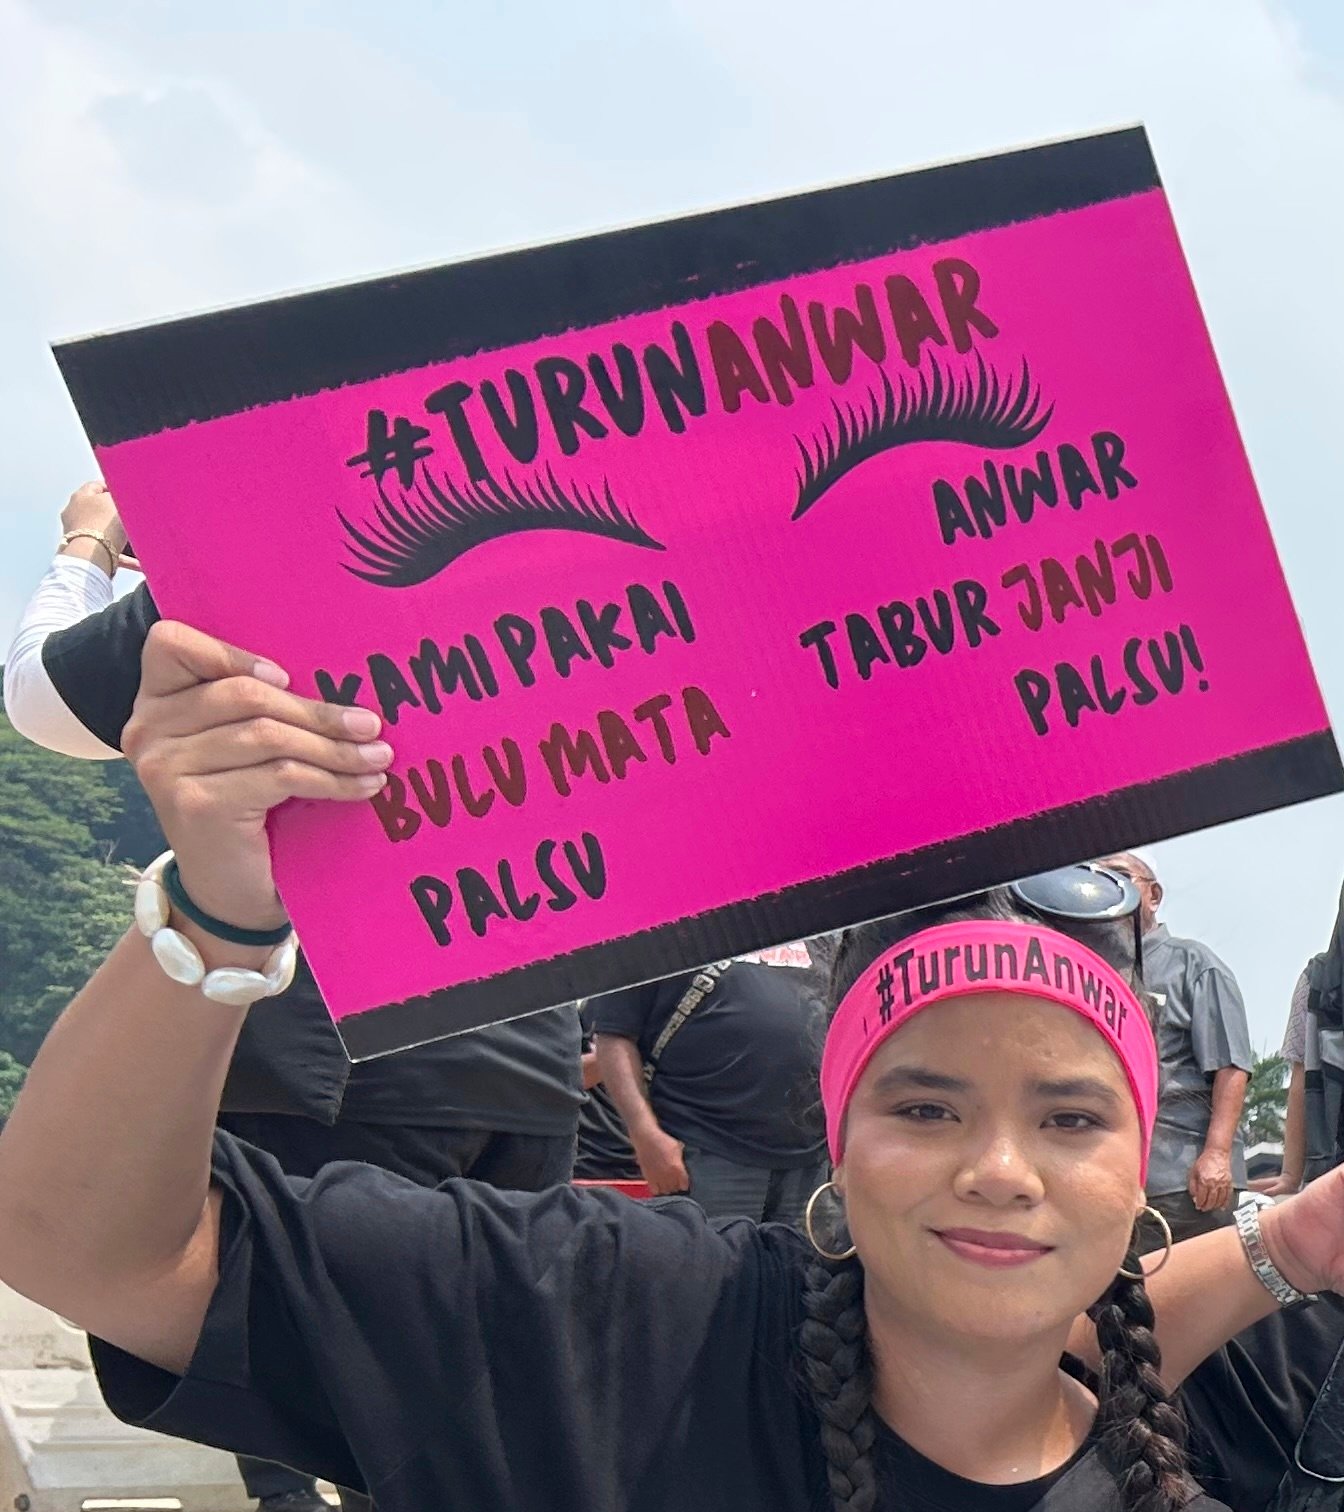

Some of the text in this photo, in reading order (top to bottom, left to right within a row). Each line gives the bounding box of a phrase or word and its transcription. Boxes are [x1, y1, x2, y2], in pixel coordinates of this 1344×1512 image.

[932, 431, 1138, 545] ANWAR
[314, 580, 697, 726] KAMI PAKAI
[799, 532, 1174, 690] TABUR JANJI
[1014, 623, 1210, 736] PALSU!
[368, 686, 732, 843] BULU MATA
[409, 831, 607, 947] PALSU
[876, 936, 1129, 1041] #TurunAnwar
